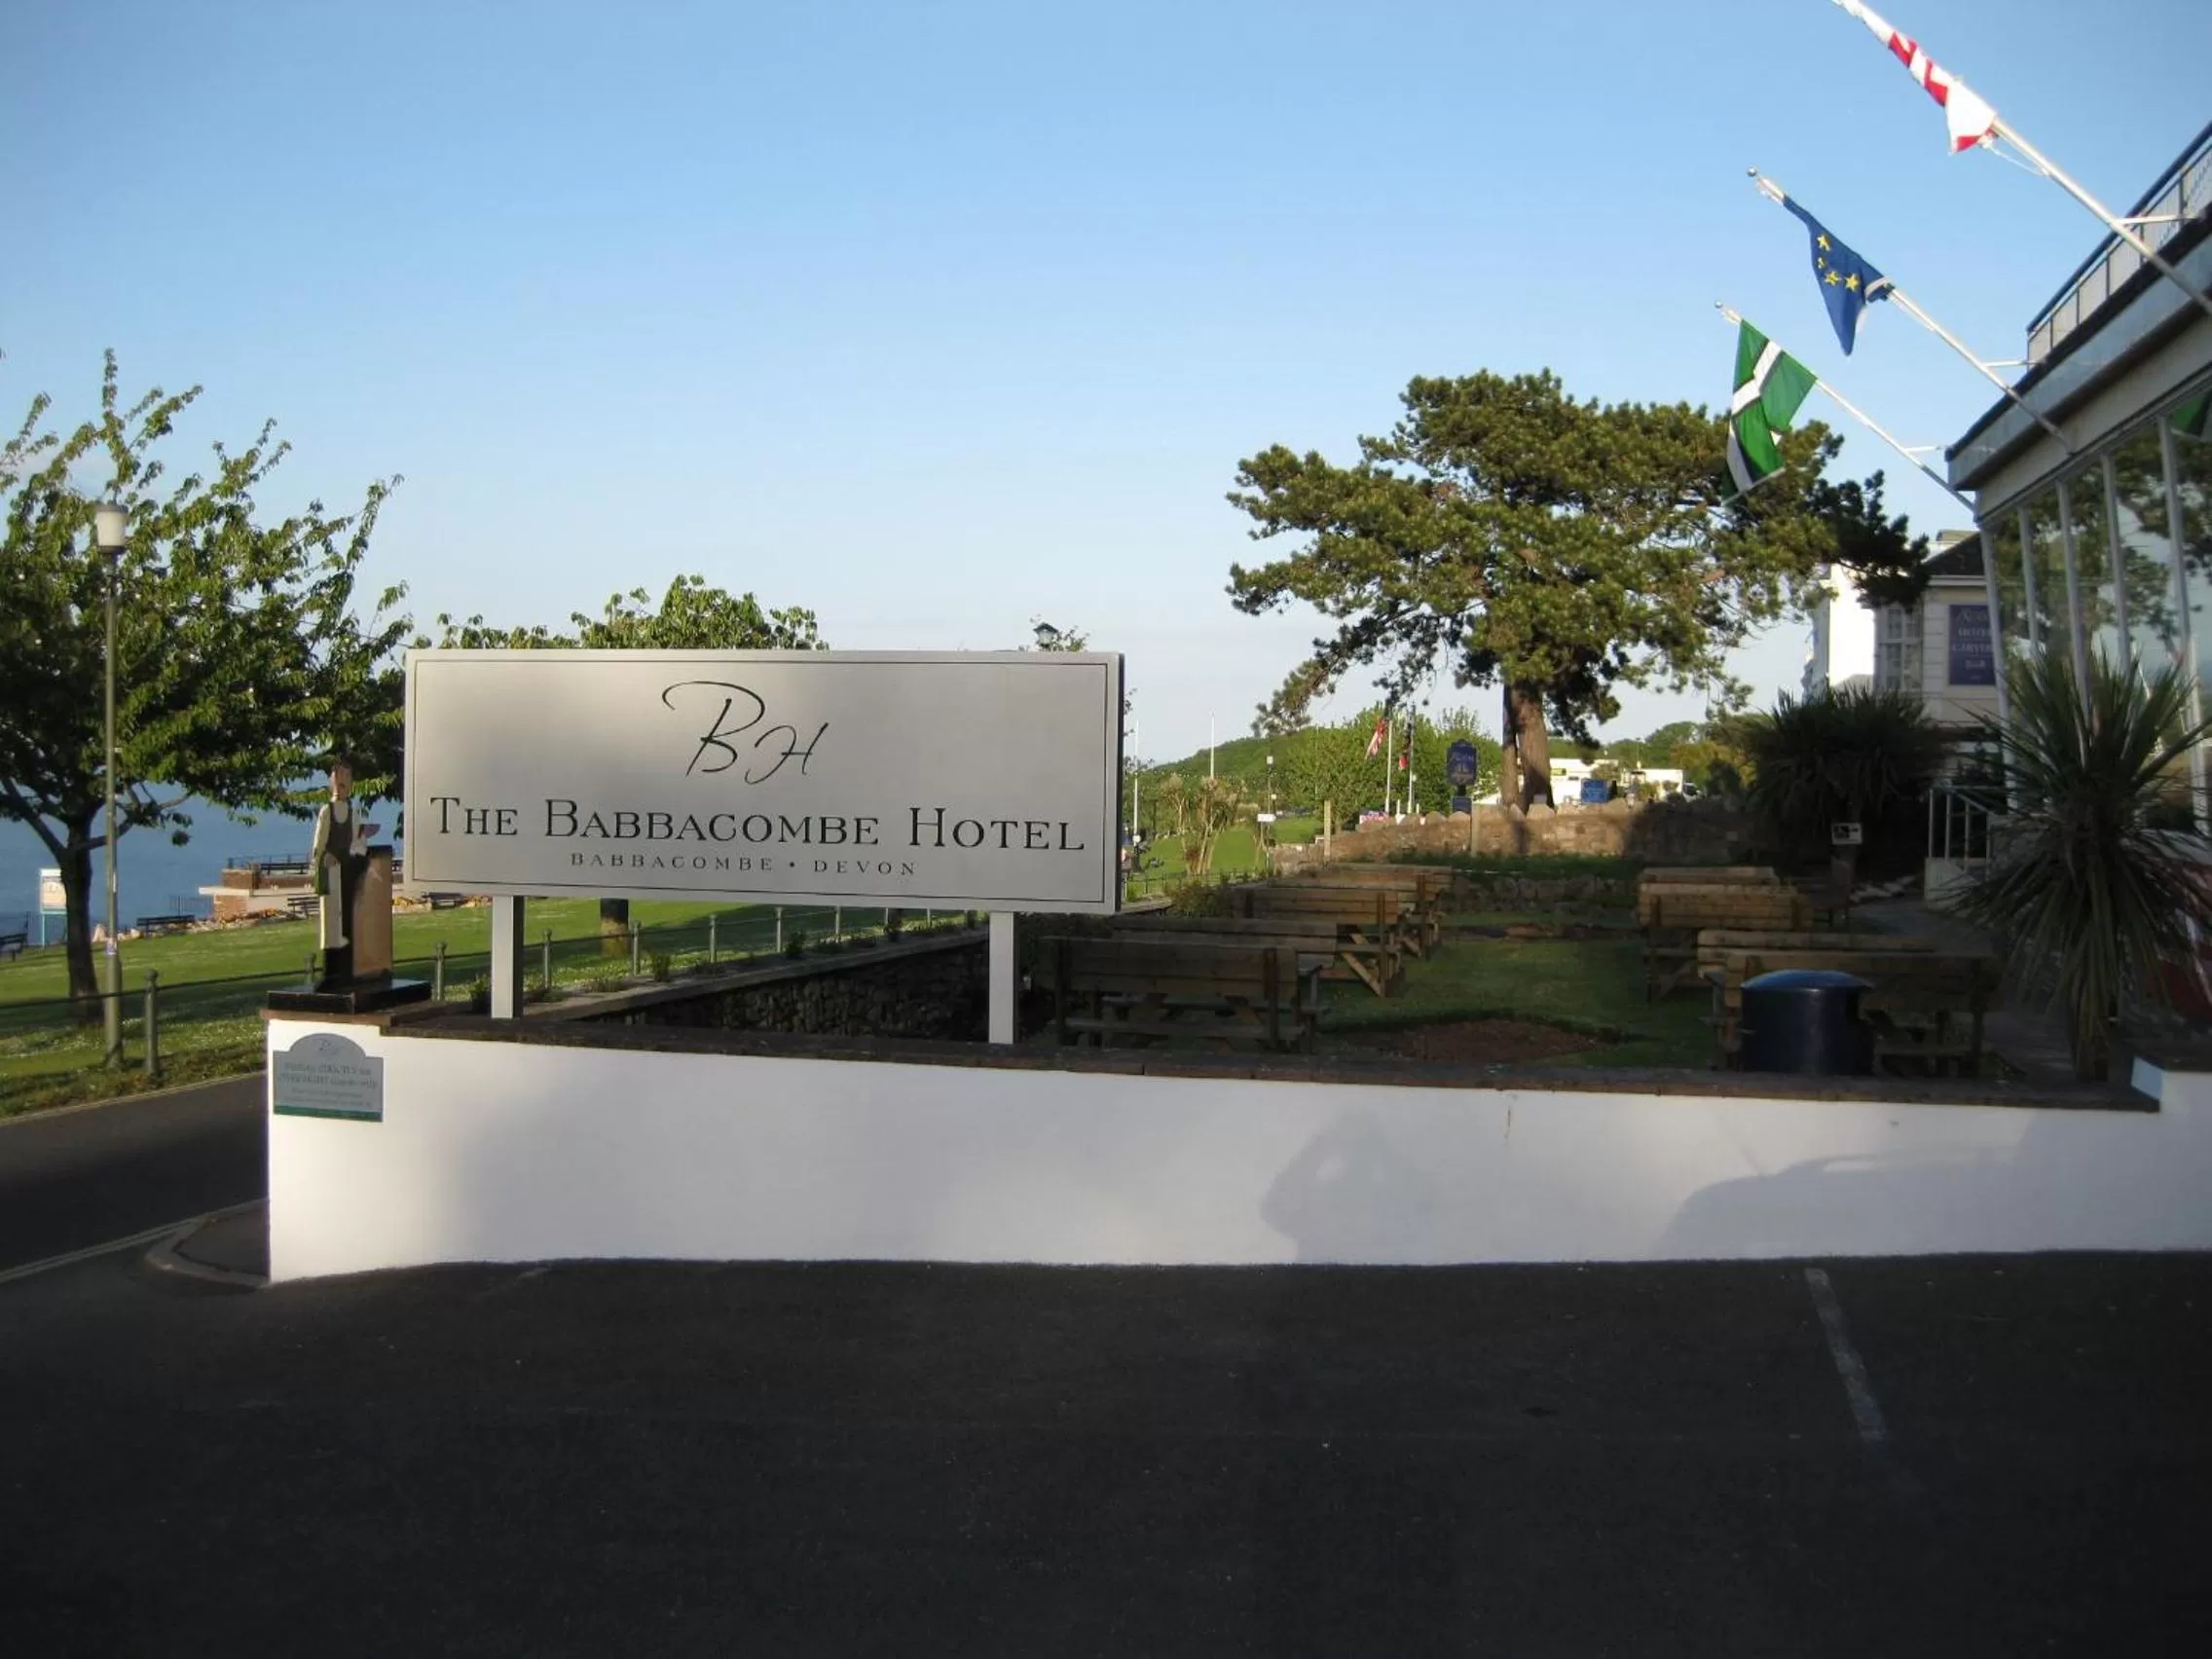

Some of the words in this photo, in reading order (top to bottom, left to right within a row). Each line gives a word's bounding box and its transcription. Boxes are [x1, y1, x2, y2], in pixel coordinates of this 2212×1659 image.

[430, 796, 518, 835] THE
[545, 799, 879, 845] BABBACOMBE
[909, 807, 1085, 851] HOTEL
[572, 853, 774, 871] BABBACOMBE
[815, 861, 914, 875] DEVON
